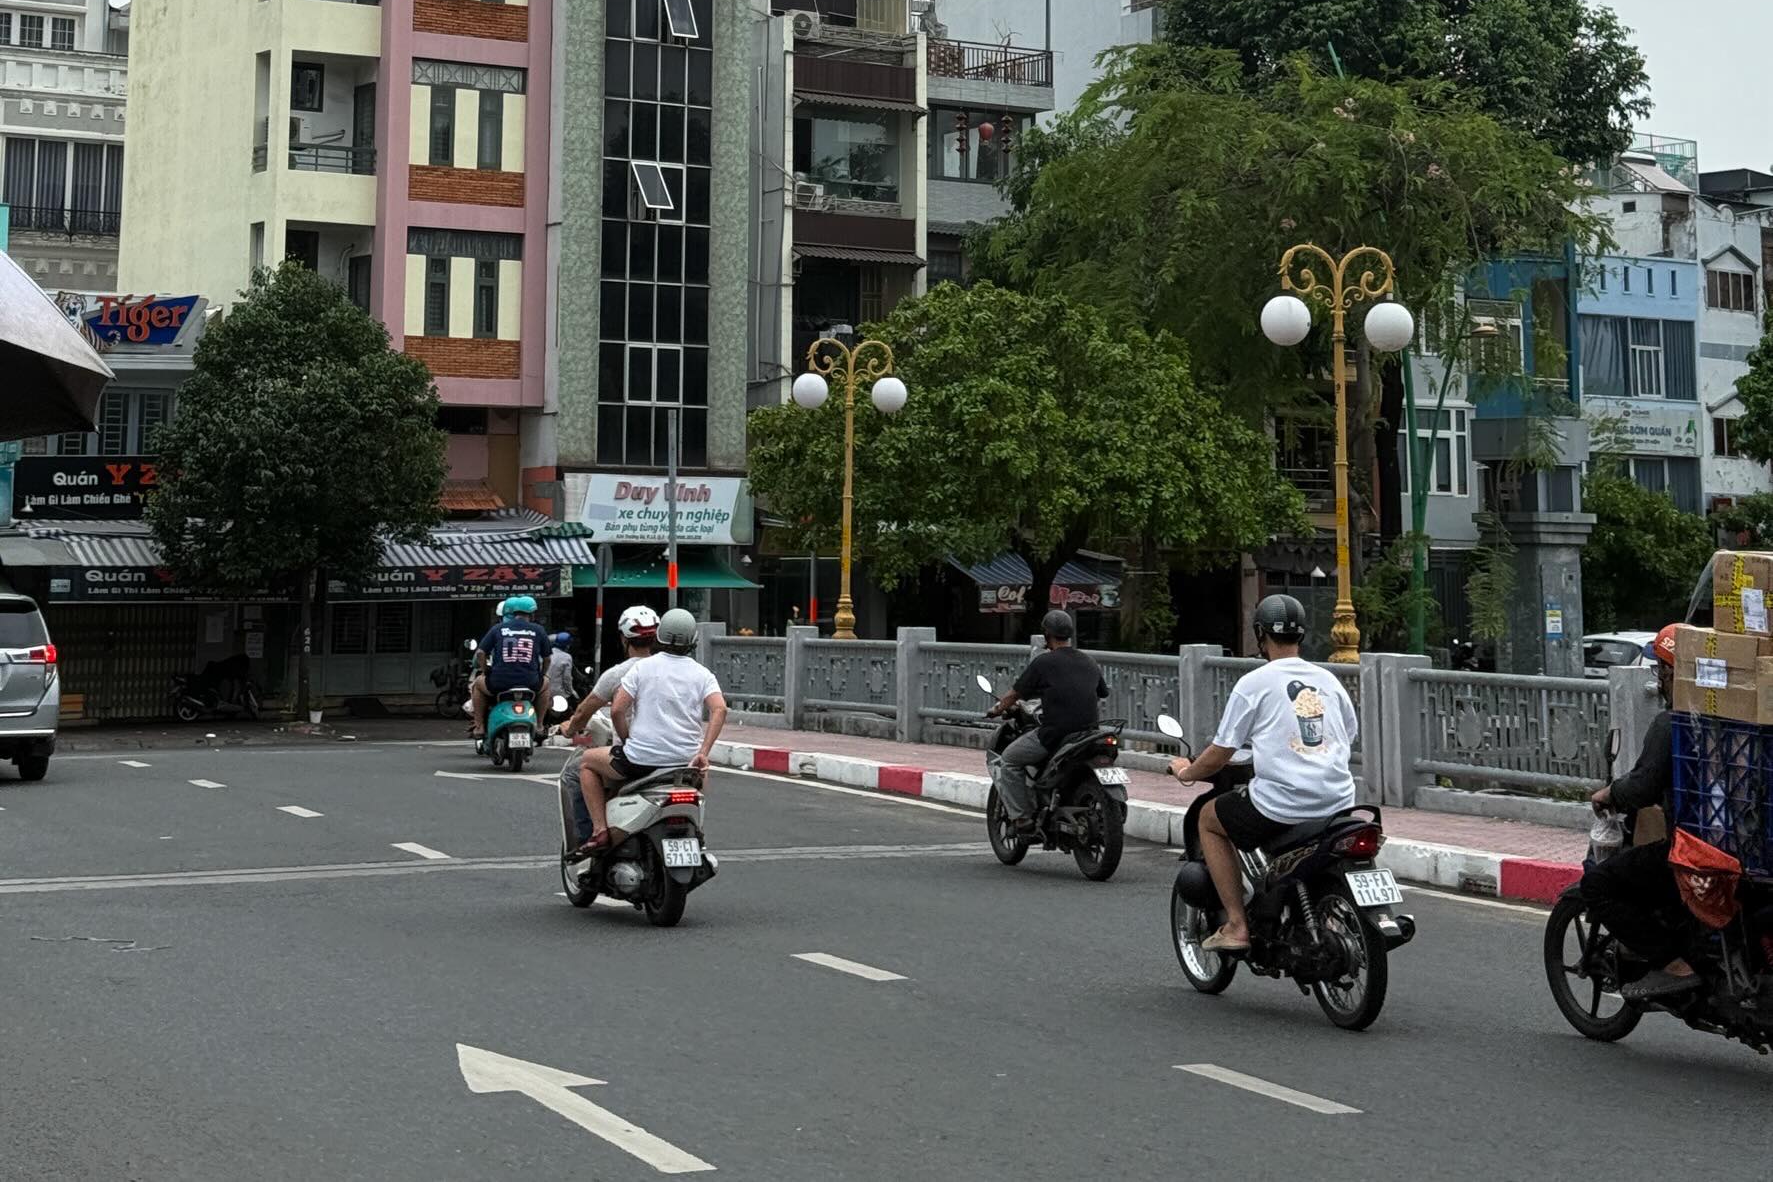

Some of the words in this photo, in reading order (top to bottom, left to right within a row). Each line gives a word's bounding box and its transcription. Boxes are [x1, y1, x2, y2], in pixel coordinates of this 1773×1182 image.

[96, 294, 188, 342] Tiger
[53, 471, 99, 486] Quán
[105, 464, 132, 485] Y
[61, 494, 81, 505] Làm
[614, 481, 660, 505] Duy
[618, 509, 634, 519] xe
[637, 507, 683, 522] chuyn
[686, 508, 730, 524] nghiệp
[622, 522, 638, 534] phụ
[639, 522, 659, 534] tùng
[659, 523, 684, 532] Hoda
[685, 524, 700, 533] các
[85, 569, 146, 582] Quán
[366, 569, 416, 582] uán
[421, 568, 449, 581] Y
[1660, 636, 1676, 652] SP
[1353, 872, 1390, 889] 59-FA
